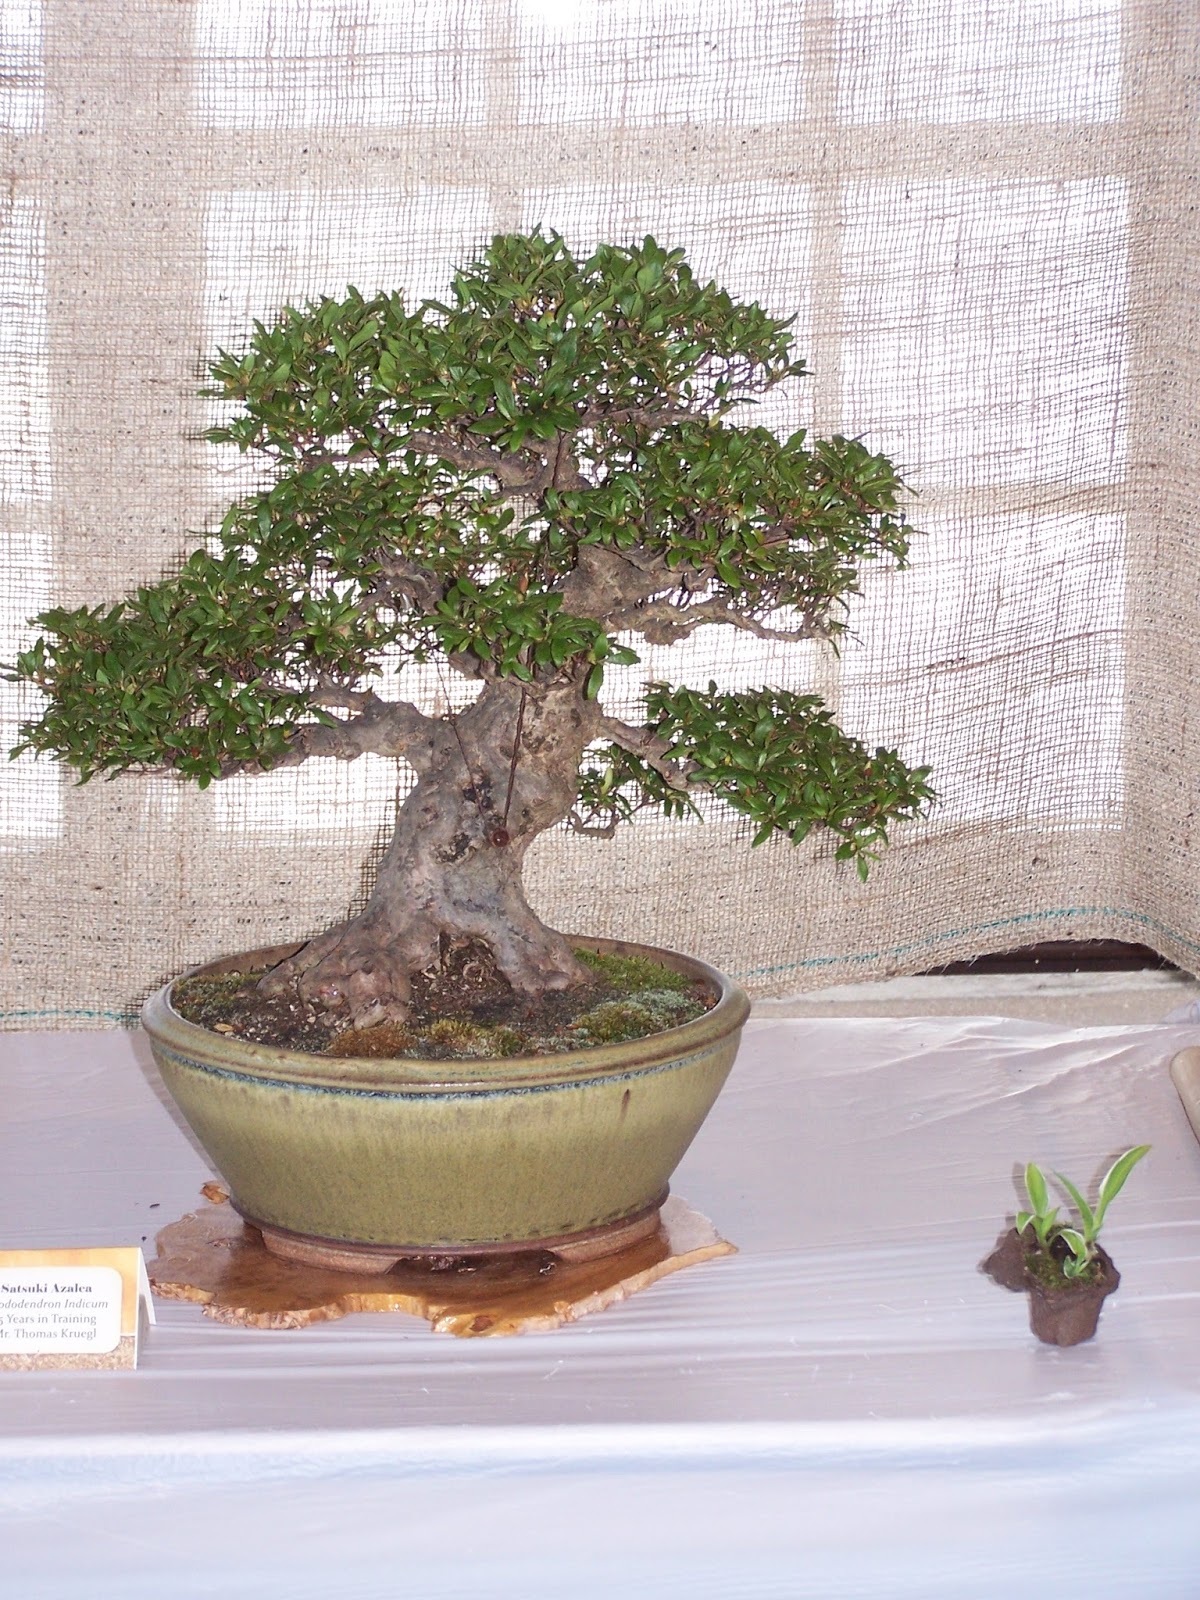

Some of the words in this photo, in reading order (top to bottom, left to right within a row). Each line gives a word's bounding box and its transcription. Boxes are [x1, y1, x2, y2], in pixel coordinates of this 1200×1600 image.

[1, 1283, 47, 1293] Satsuki
[51, 1283, 92, 1293] Azalea
[64, 1299, 109, 1309] Indicum
[7, 1314, 34, 1324] Years
[38, 1314, 48, 1324] in
[51, 1313, 97, 1326] Training
[14, 1328, 58, 1338] Thomas
[61, 1328, 97, 1341] Kruegl
